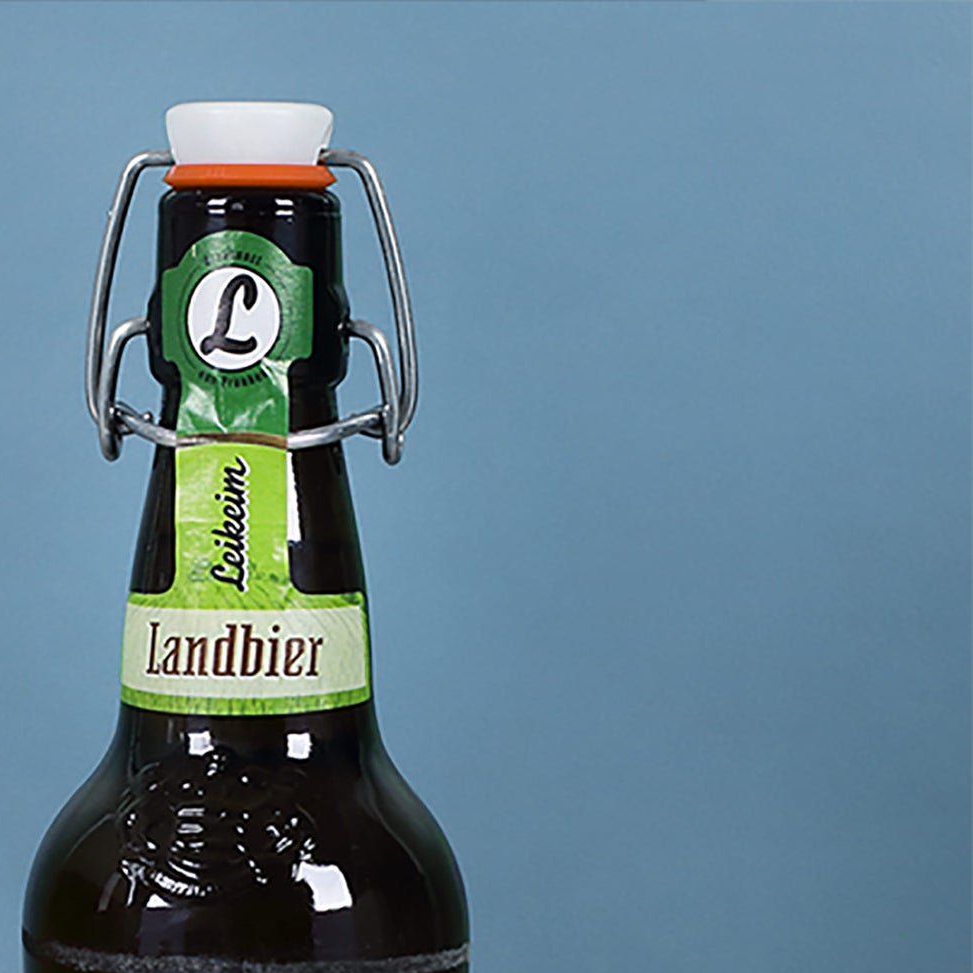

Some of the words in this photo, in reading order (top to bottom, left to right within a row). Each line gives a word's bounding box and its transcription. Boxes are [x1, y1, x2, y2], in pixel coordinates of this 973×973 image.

[200, 273, 258, 356] L
[210, 456, 247, 592] Leikeim
[145, 621, 323, 677] Landbier
